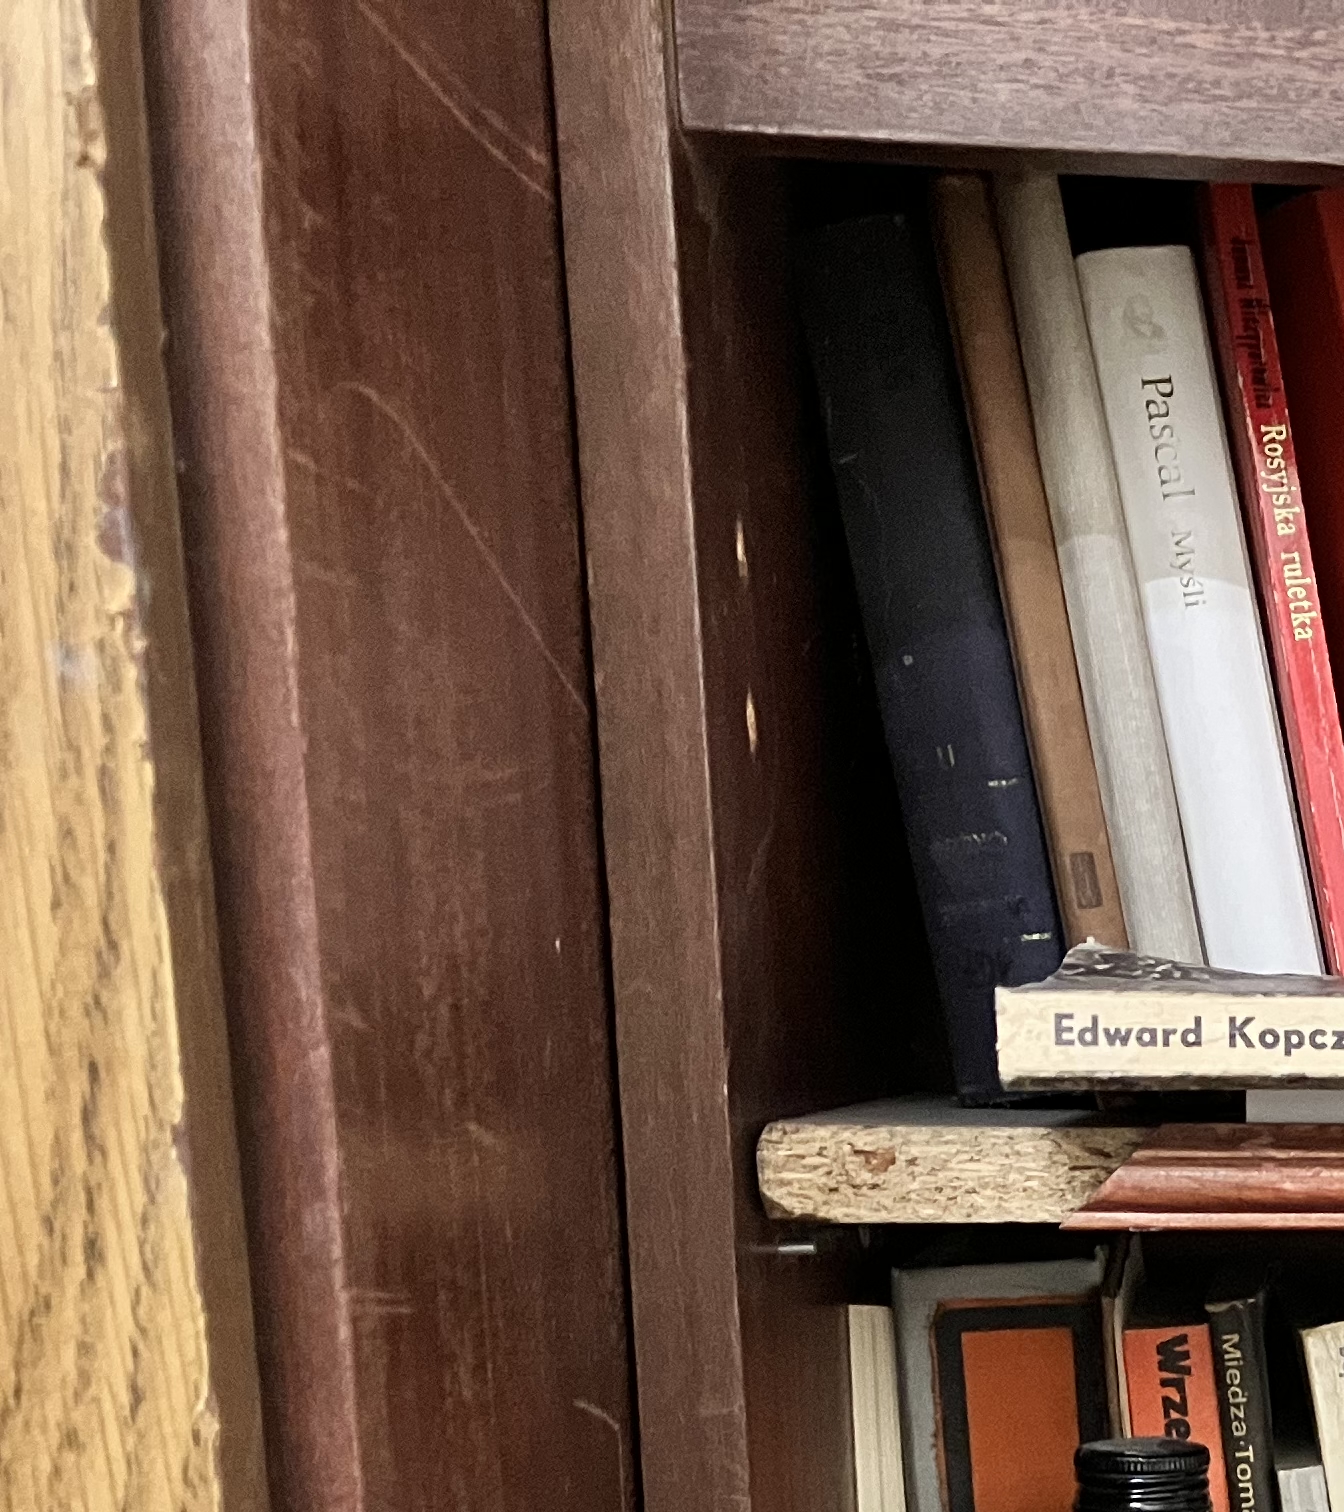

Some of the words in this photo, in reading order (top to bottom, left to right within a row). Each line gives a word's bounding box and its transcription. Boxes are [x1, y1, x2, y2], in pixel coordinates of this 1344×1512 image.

[1141, 373, 1195, 501] Pascal
[1171, 530, 1207, 610] Myśli
[1260, 424, 1301, 537] Rosyjska
[1280, 550, 1319, 642] ruletka
[1053, 1012, 1203, 1048] Edward
